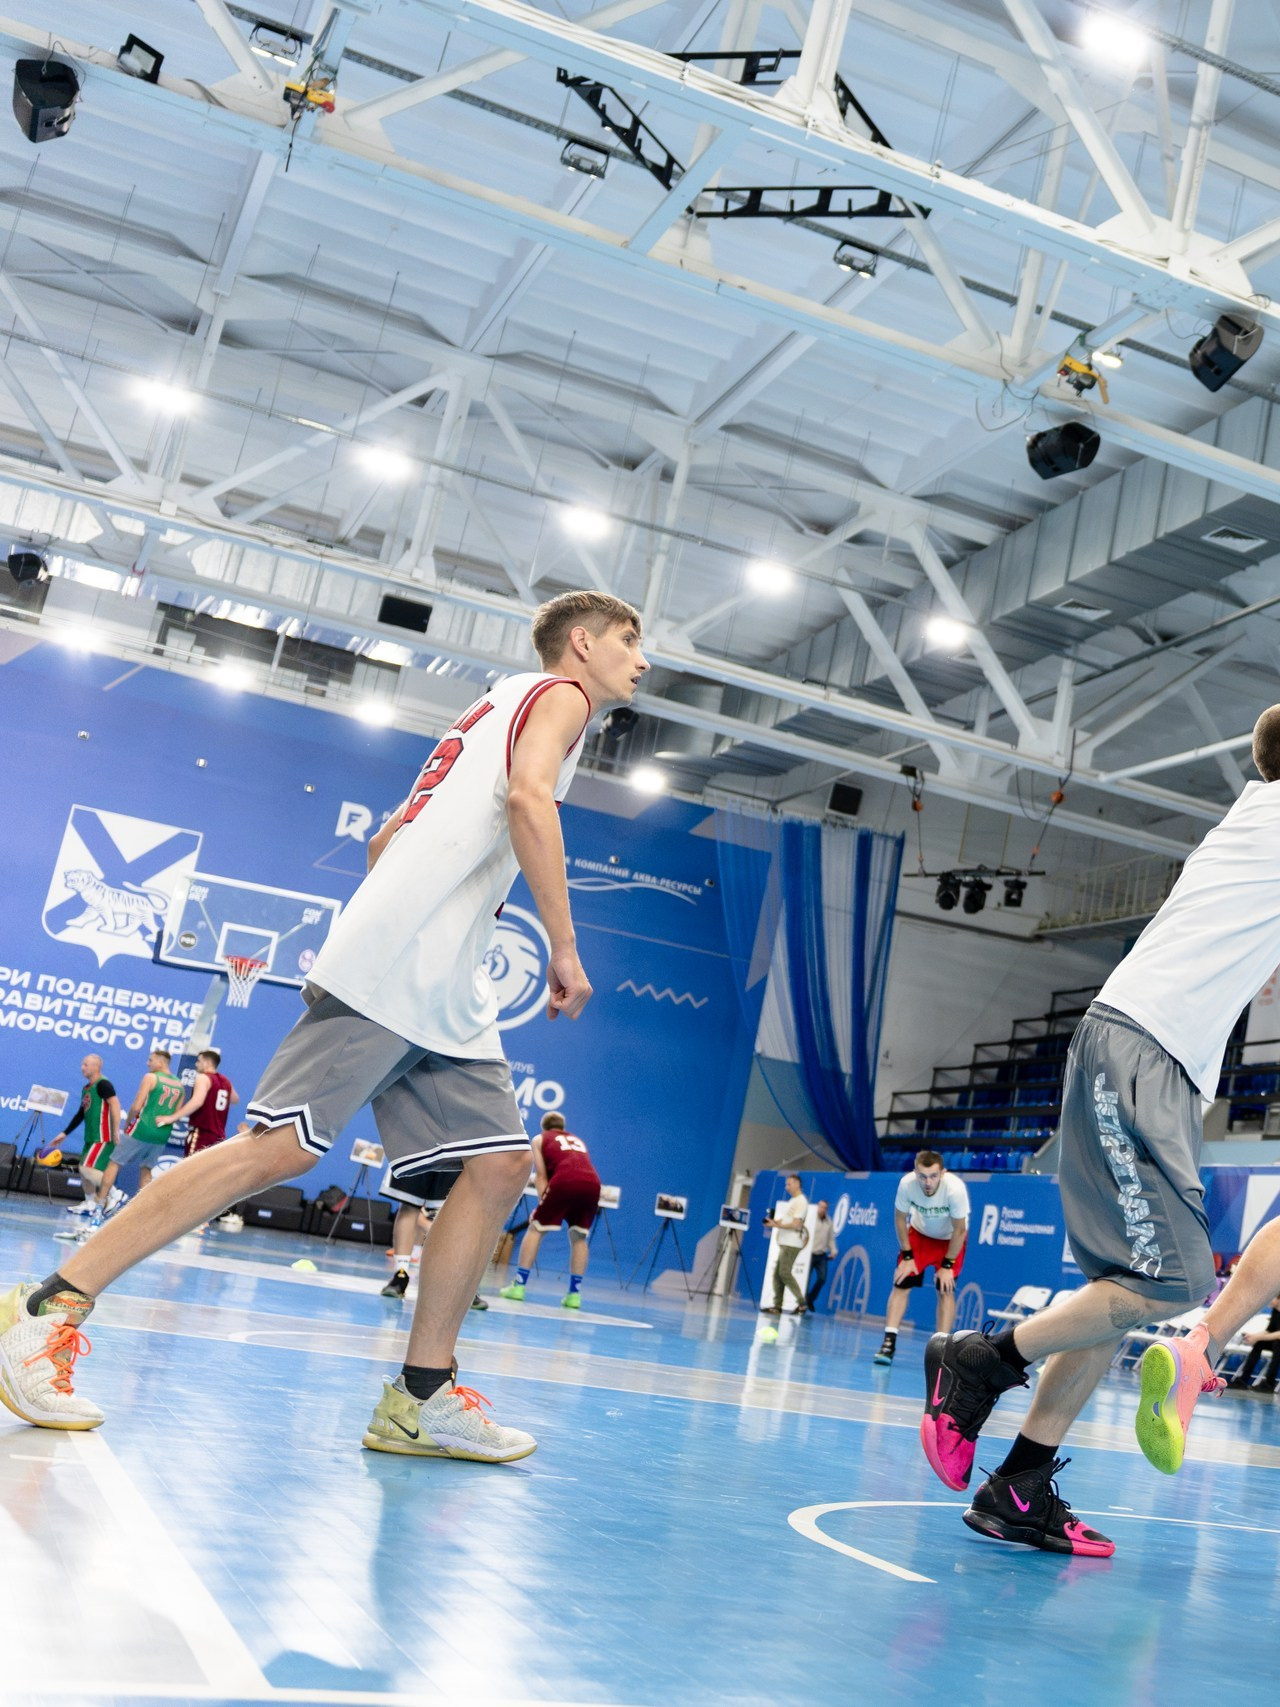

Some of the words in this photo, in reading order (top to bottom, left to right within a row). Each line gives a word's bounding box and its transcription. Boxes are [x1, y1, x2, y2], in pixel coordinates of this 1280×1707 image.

[574, 858, 630, 878] КОМПАНИЙ
[632, 871, 702, 895] АКВА-РЕСУРСЫ
[36, 973, 203, 1020] ПОДДЕРЖКЕ
[215, 1089, 228, 1111] 6
[555, 1135, 587, 1153] 13
[1094, 1072, 1161, 1258] JORDAN
